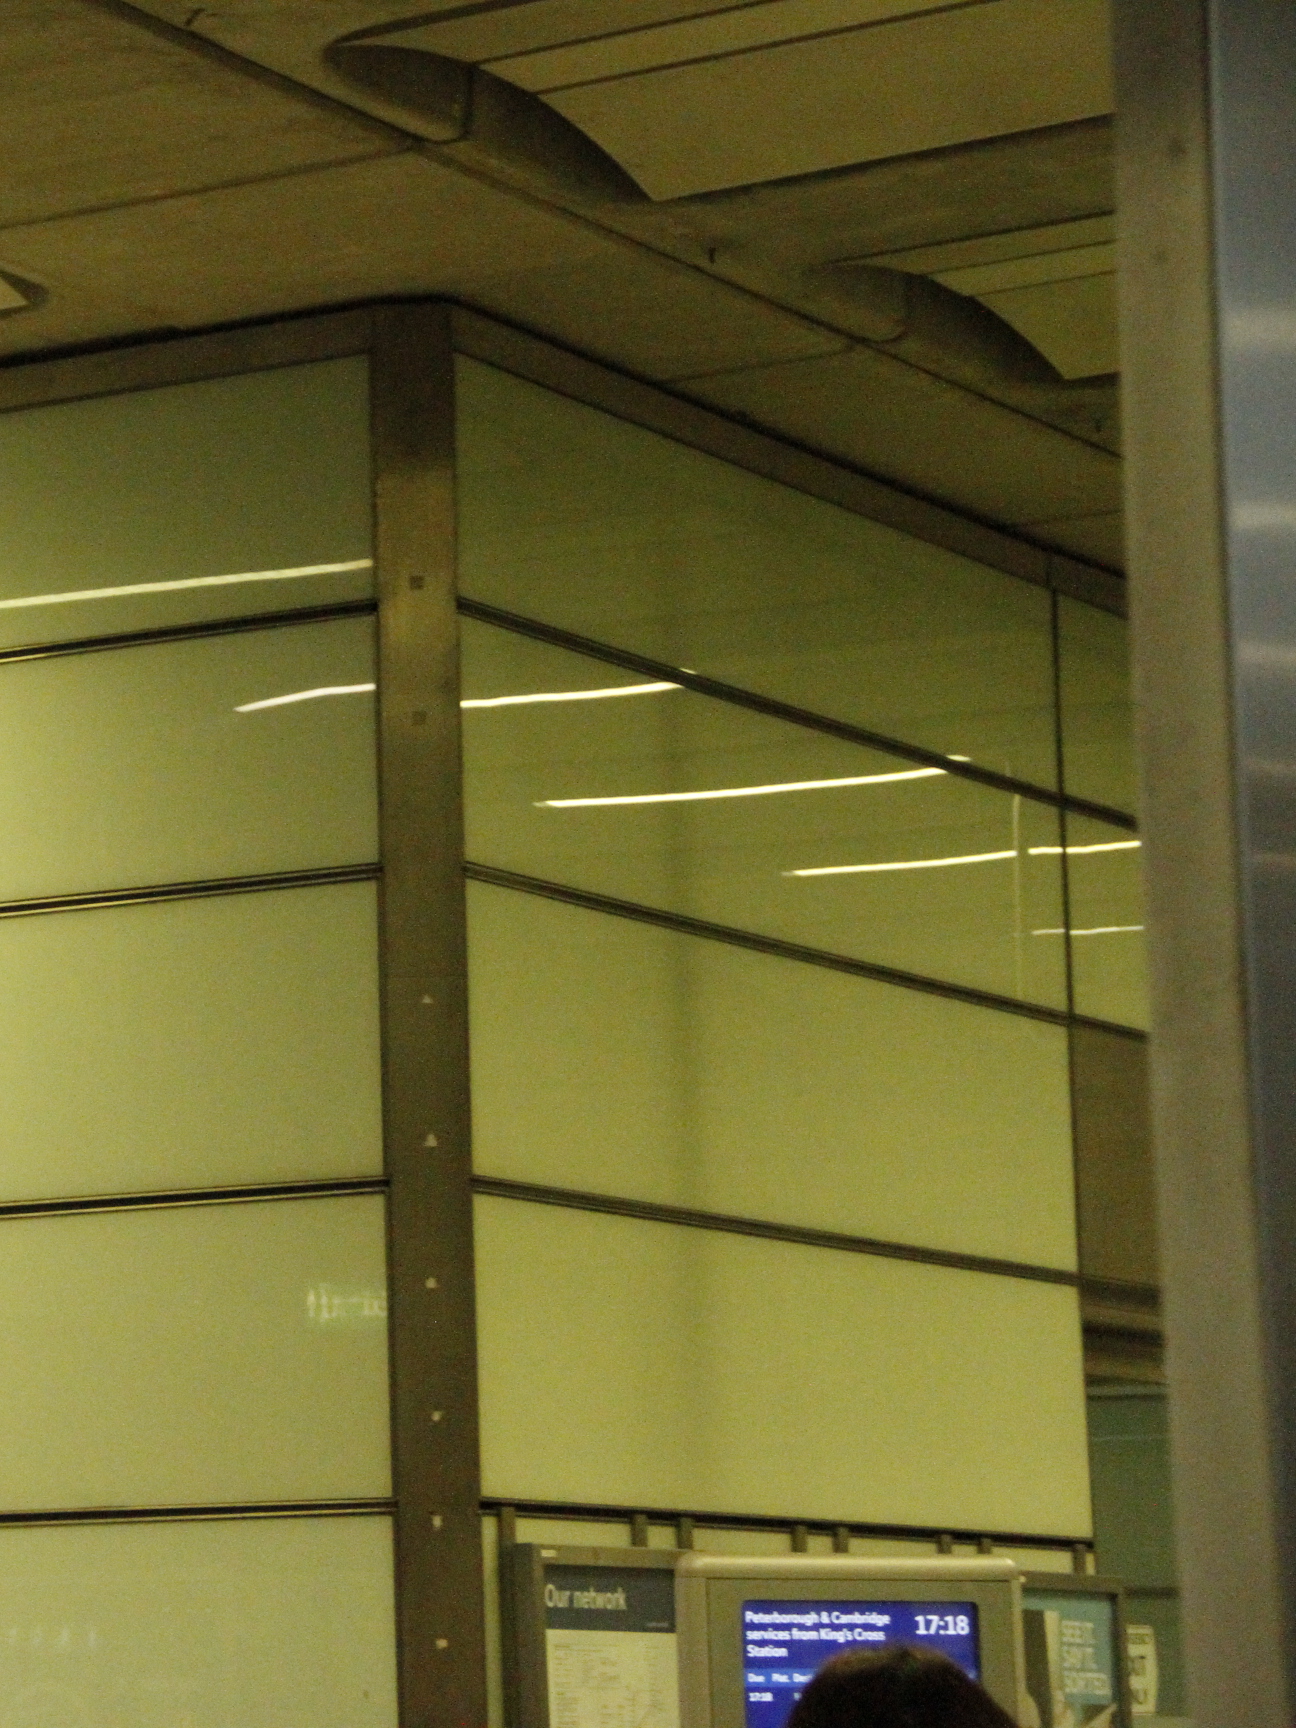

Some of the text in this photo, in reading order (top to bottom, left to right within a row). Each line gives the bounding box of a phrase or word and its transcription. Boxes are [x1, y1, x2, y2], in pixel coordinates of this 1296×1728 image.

[544, 1584, 628, 1611] Our network
[745, 1611, 891, 1626] Peterborough & Cambridge
[914, 1615, 970, 1635] 17:18
[746, 1628, 886, 1643] services from King's Cross
[746, 1644, 788, 1657] Station
